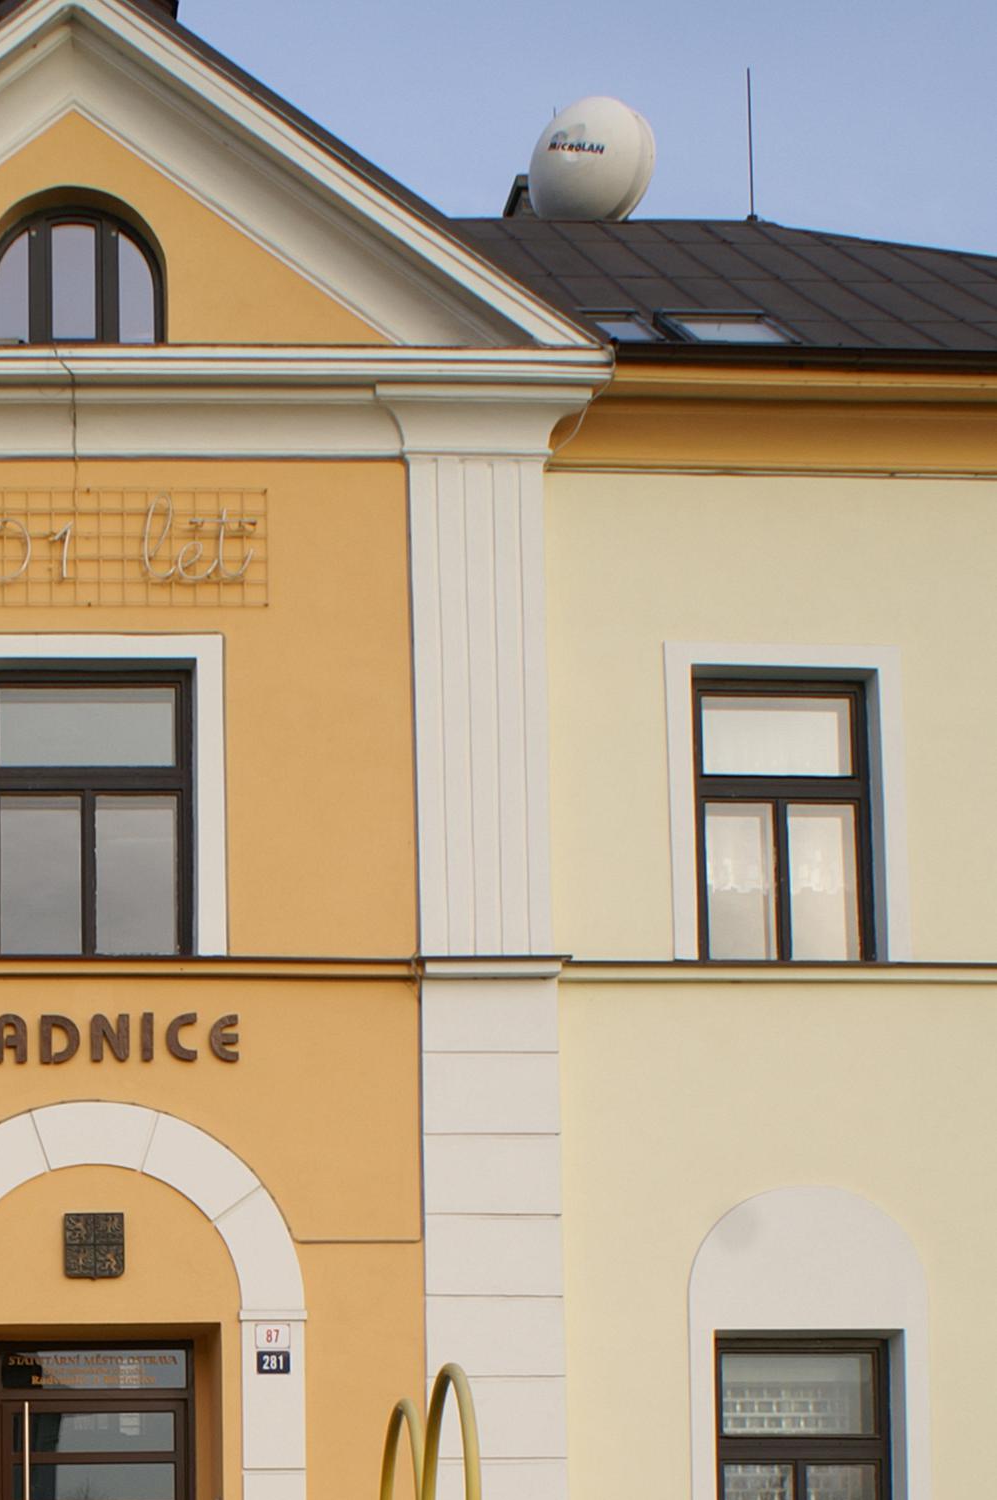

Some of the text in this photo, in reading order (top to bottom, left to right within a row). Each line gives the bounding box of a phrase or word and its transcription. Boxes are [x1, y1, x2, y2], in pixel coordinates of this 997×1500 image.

[142, 490, 258, 582] let
[266, 1328, 280, 1343] 87
[262, 1354, 284, 1370] 281
